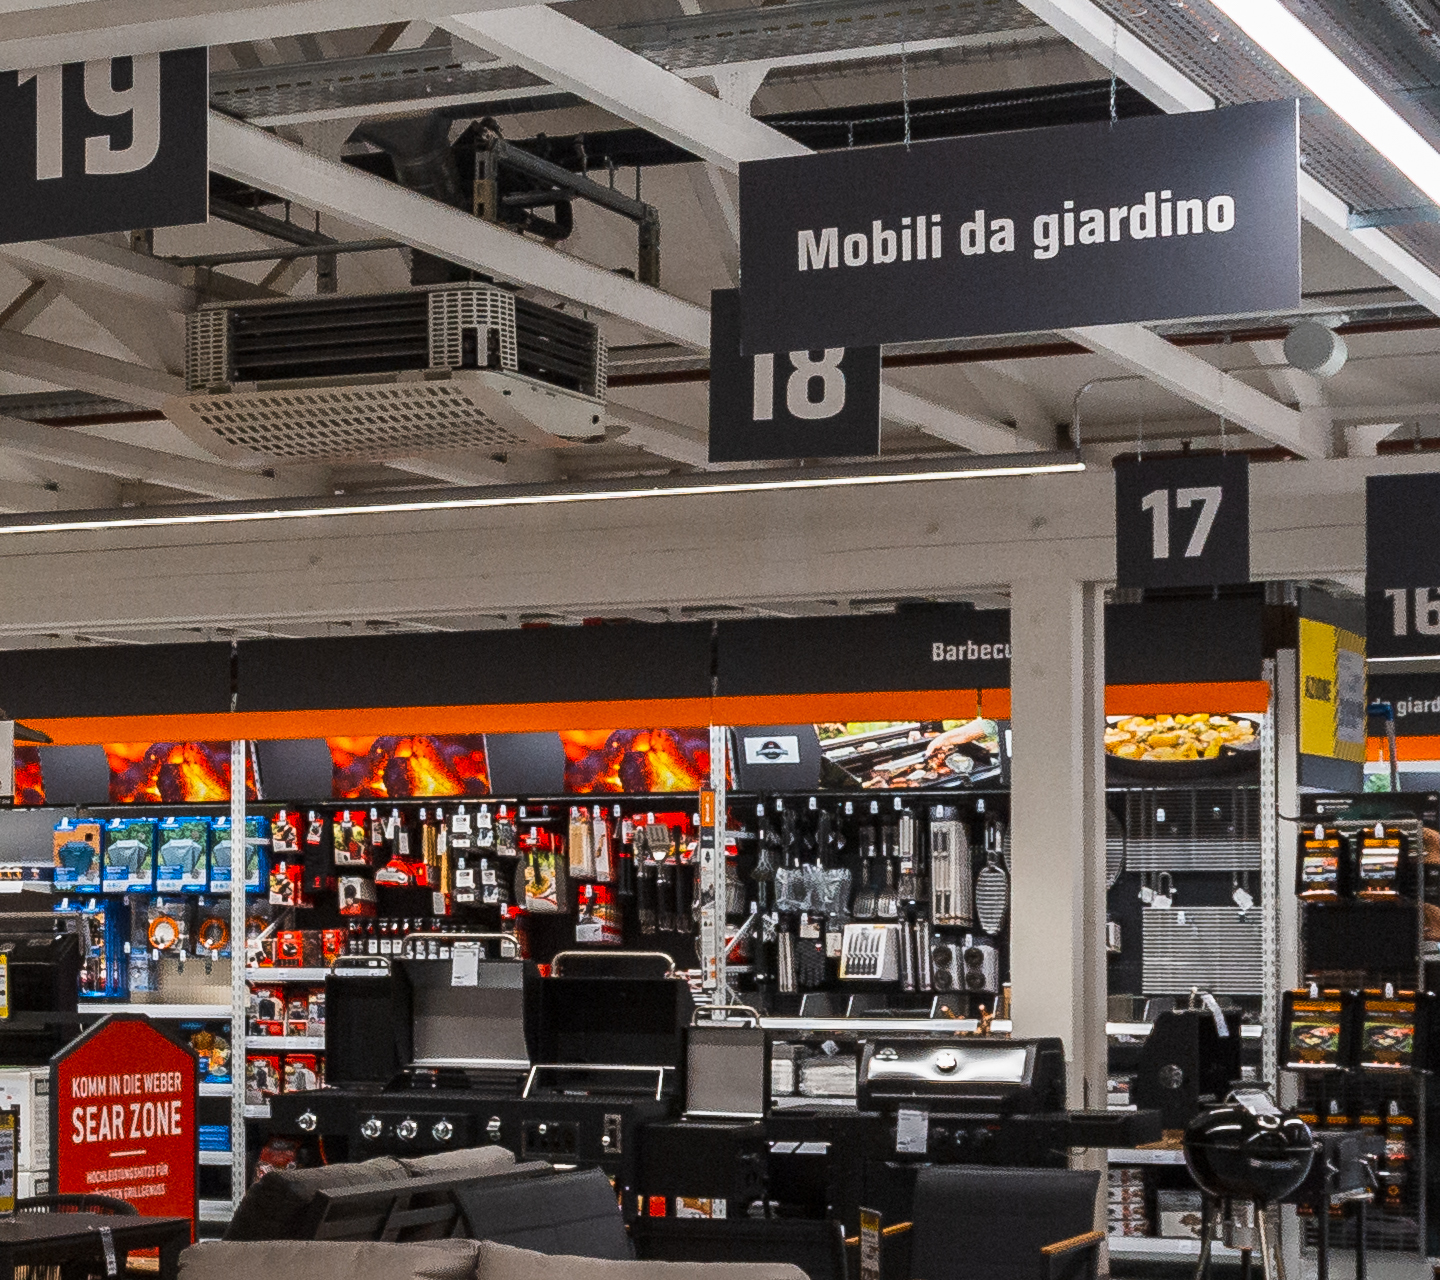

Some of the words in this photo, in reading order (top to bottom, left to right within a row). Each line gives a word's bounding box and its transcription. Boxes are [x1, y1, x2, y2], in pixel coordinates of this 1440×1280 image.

[16, 47, 161, 181] 19
[797, 213, 943, 272] Mobili
[960, 208, 1015, 256] da
[1033, 189, 1236, 260] giardino
[752, 347, 847, 421] 18
[1141, 485, 1223, 559] 17
[71, 1075, 107, 1099] KOMM
[109, 1074, 121, 1096] IN
[123, 1073, 141, 1095] DIE
[142, 1071, 183, 1094] WEBER
[71, 1104, 125, 1144] SEAR
[129, 1099, 183, 1139] ZONE
